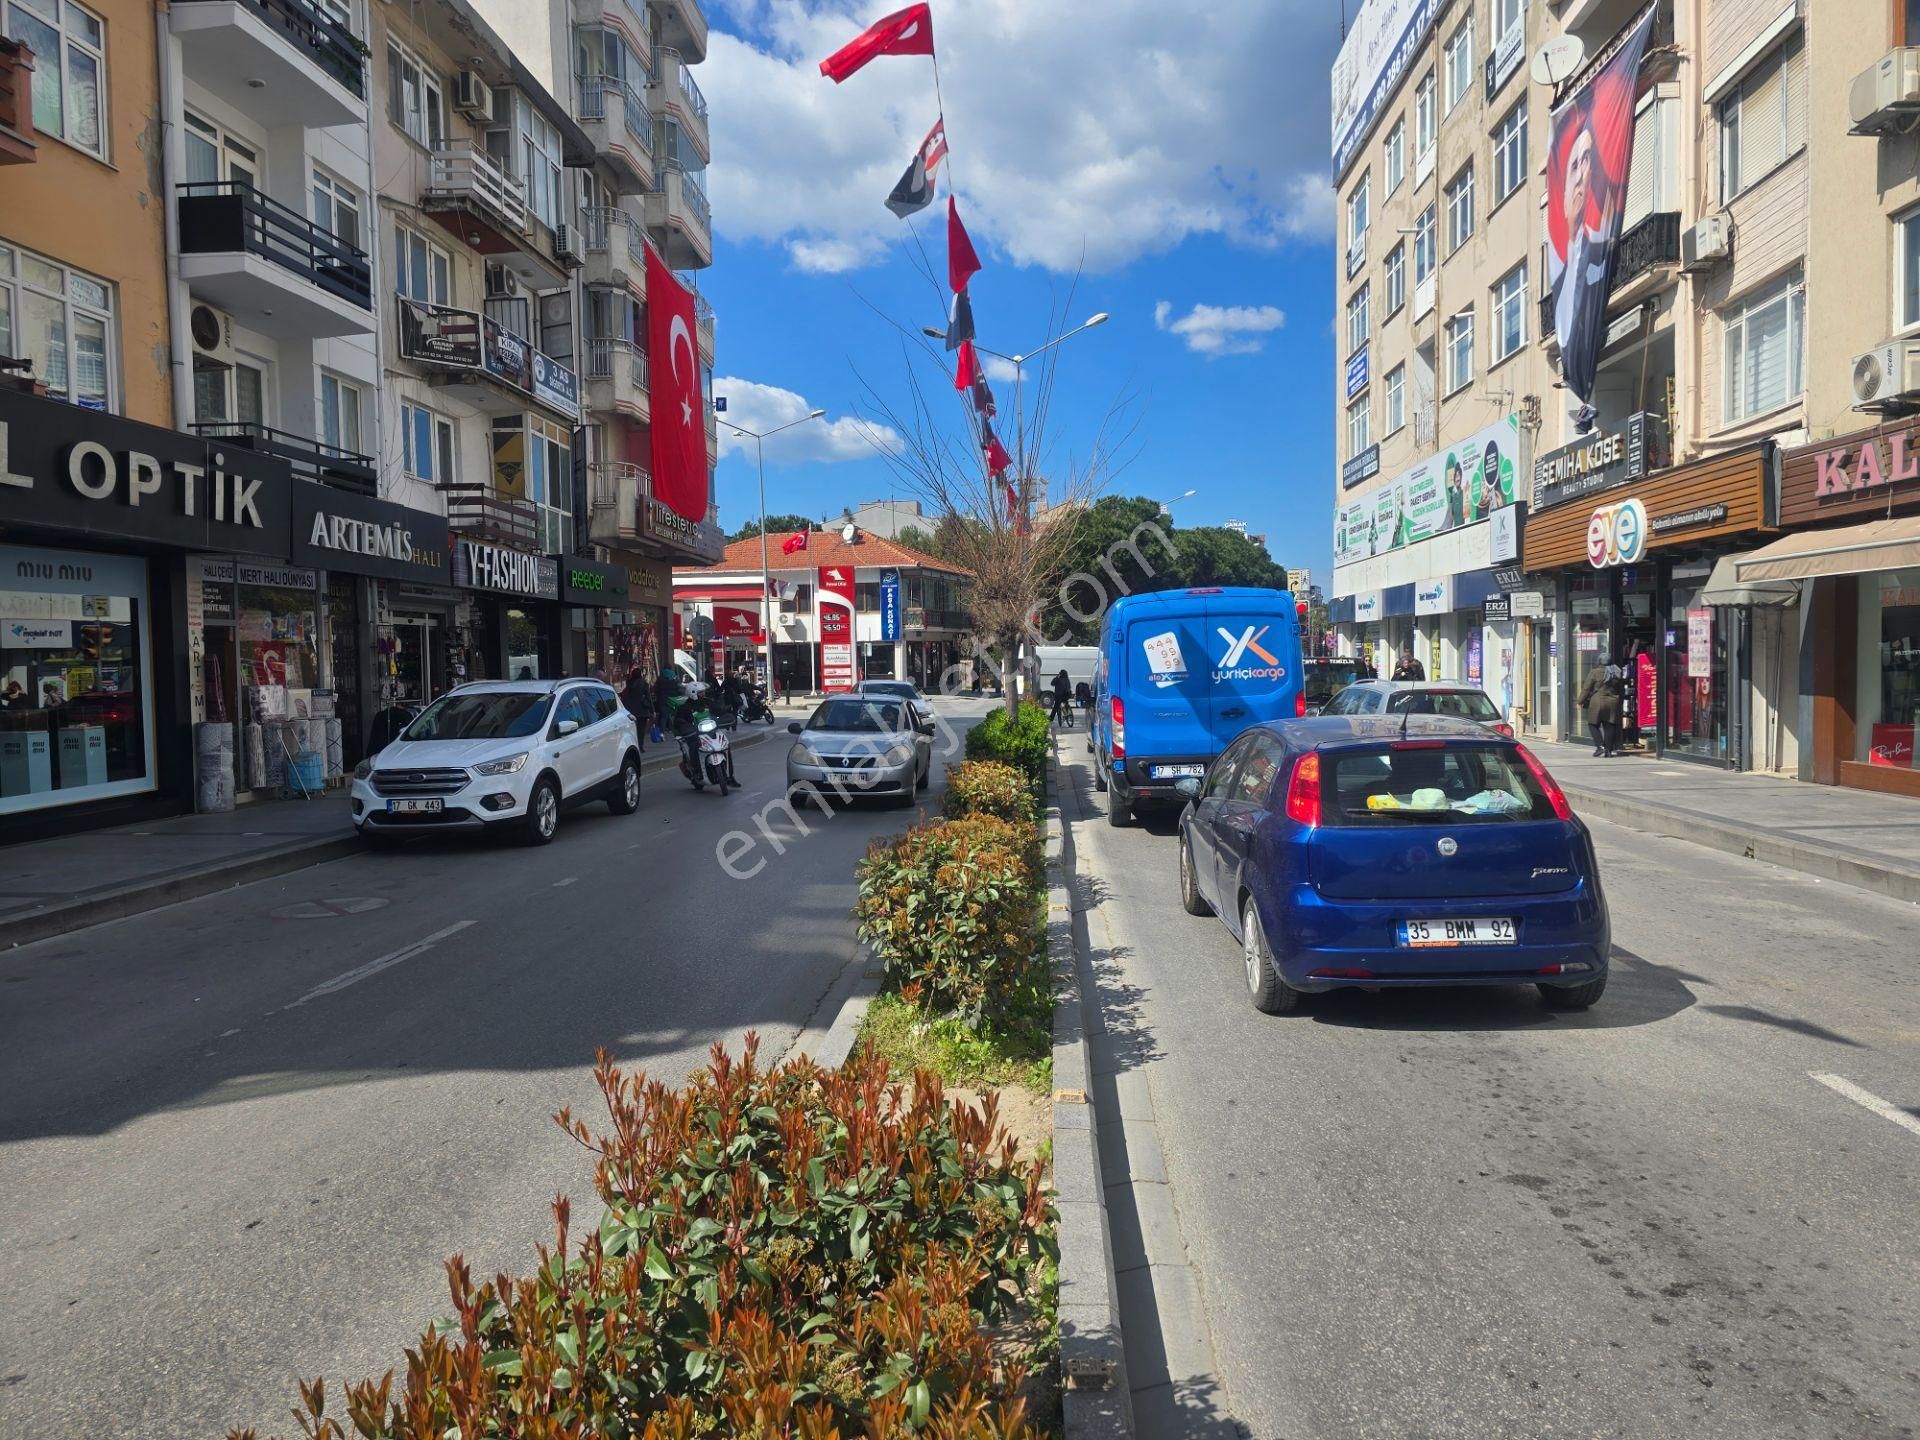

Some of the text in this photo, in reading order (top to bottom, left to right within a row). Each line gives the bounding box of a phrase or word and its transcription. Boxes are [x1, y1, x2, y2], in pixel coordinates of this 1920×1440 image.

[1541, 446, 1583, 487] SEMİHA
[1814, 432, 1918, 497] KAL
[68, 441, 264, 529] OPTİK
[1562, 472, 1605, 496] BEAUTY STUDIO
[307, 511, 441, 568] ARTEMİS HALI
[1586, 500, 1646, 568] eve
[240, 567, 262, 583] MERT
[264, 571, 282, 585] HALI
[466, 543, 539, 595] Y-FASHION
[628, 567, 661, 588] vodafone
[1495, 569, 1522, 585] ERZİ
[1485, 600, 1508, 610] ERZİ
[1211, 666, 1286, 684] yurtiçikargo
[1156, 764, 1204, 775] 17 SH 782
[392, 798, 441, 812] 17 GK 443
[1409, 920, 1513, 939] 35 BMM 92
